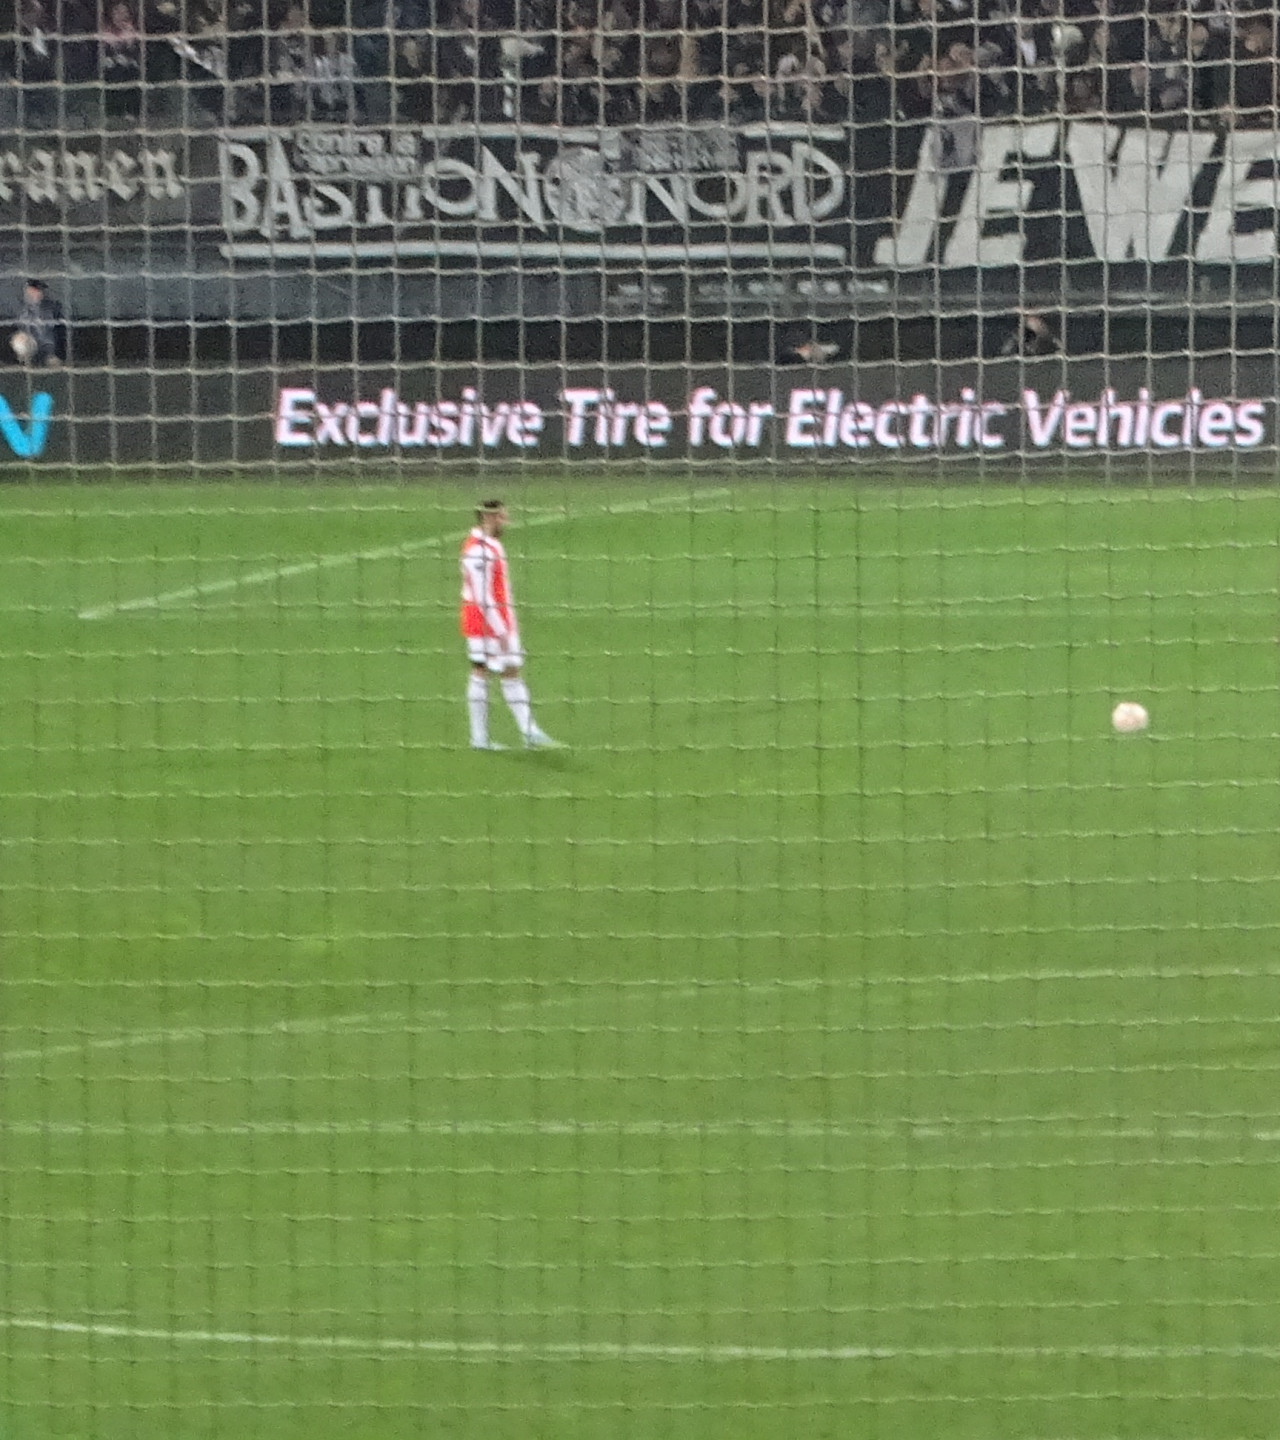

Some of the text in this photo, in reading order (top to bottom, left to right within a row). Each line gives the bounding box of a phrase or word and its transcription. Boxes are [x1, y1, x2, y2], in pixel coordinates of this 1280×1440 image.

[626, 140, 845, 228] NORD
[275, 386, 1266, 448] Exclusive Tire for Electric Vehicles
